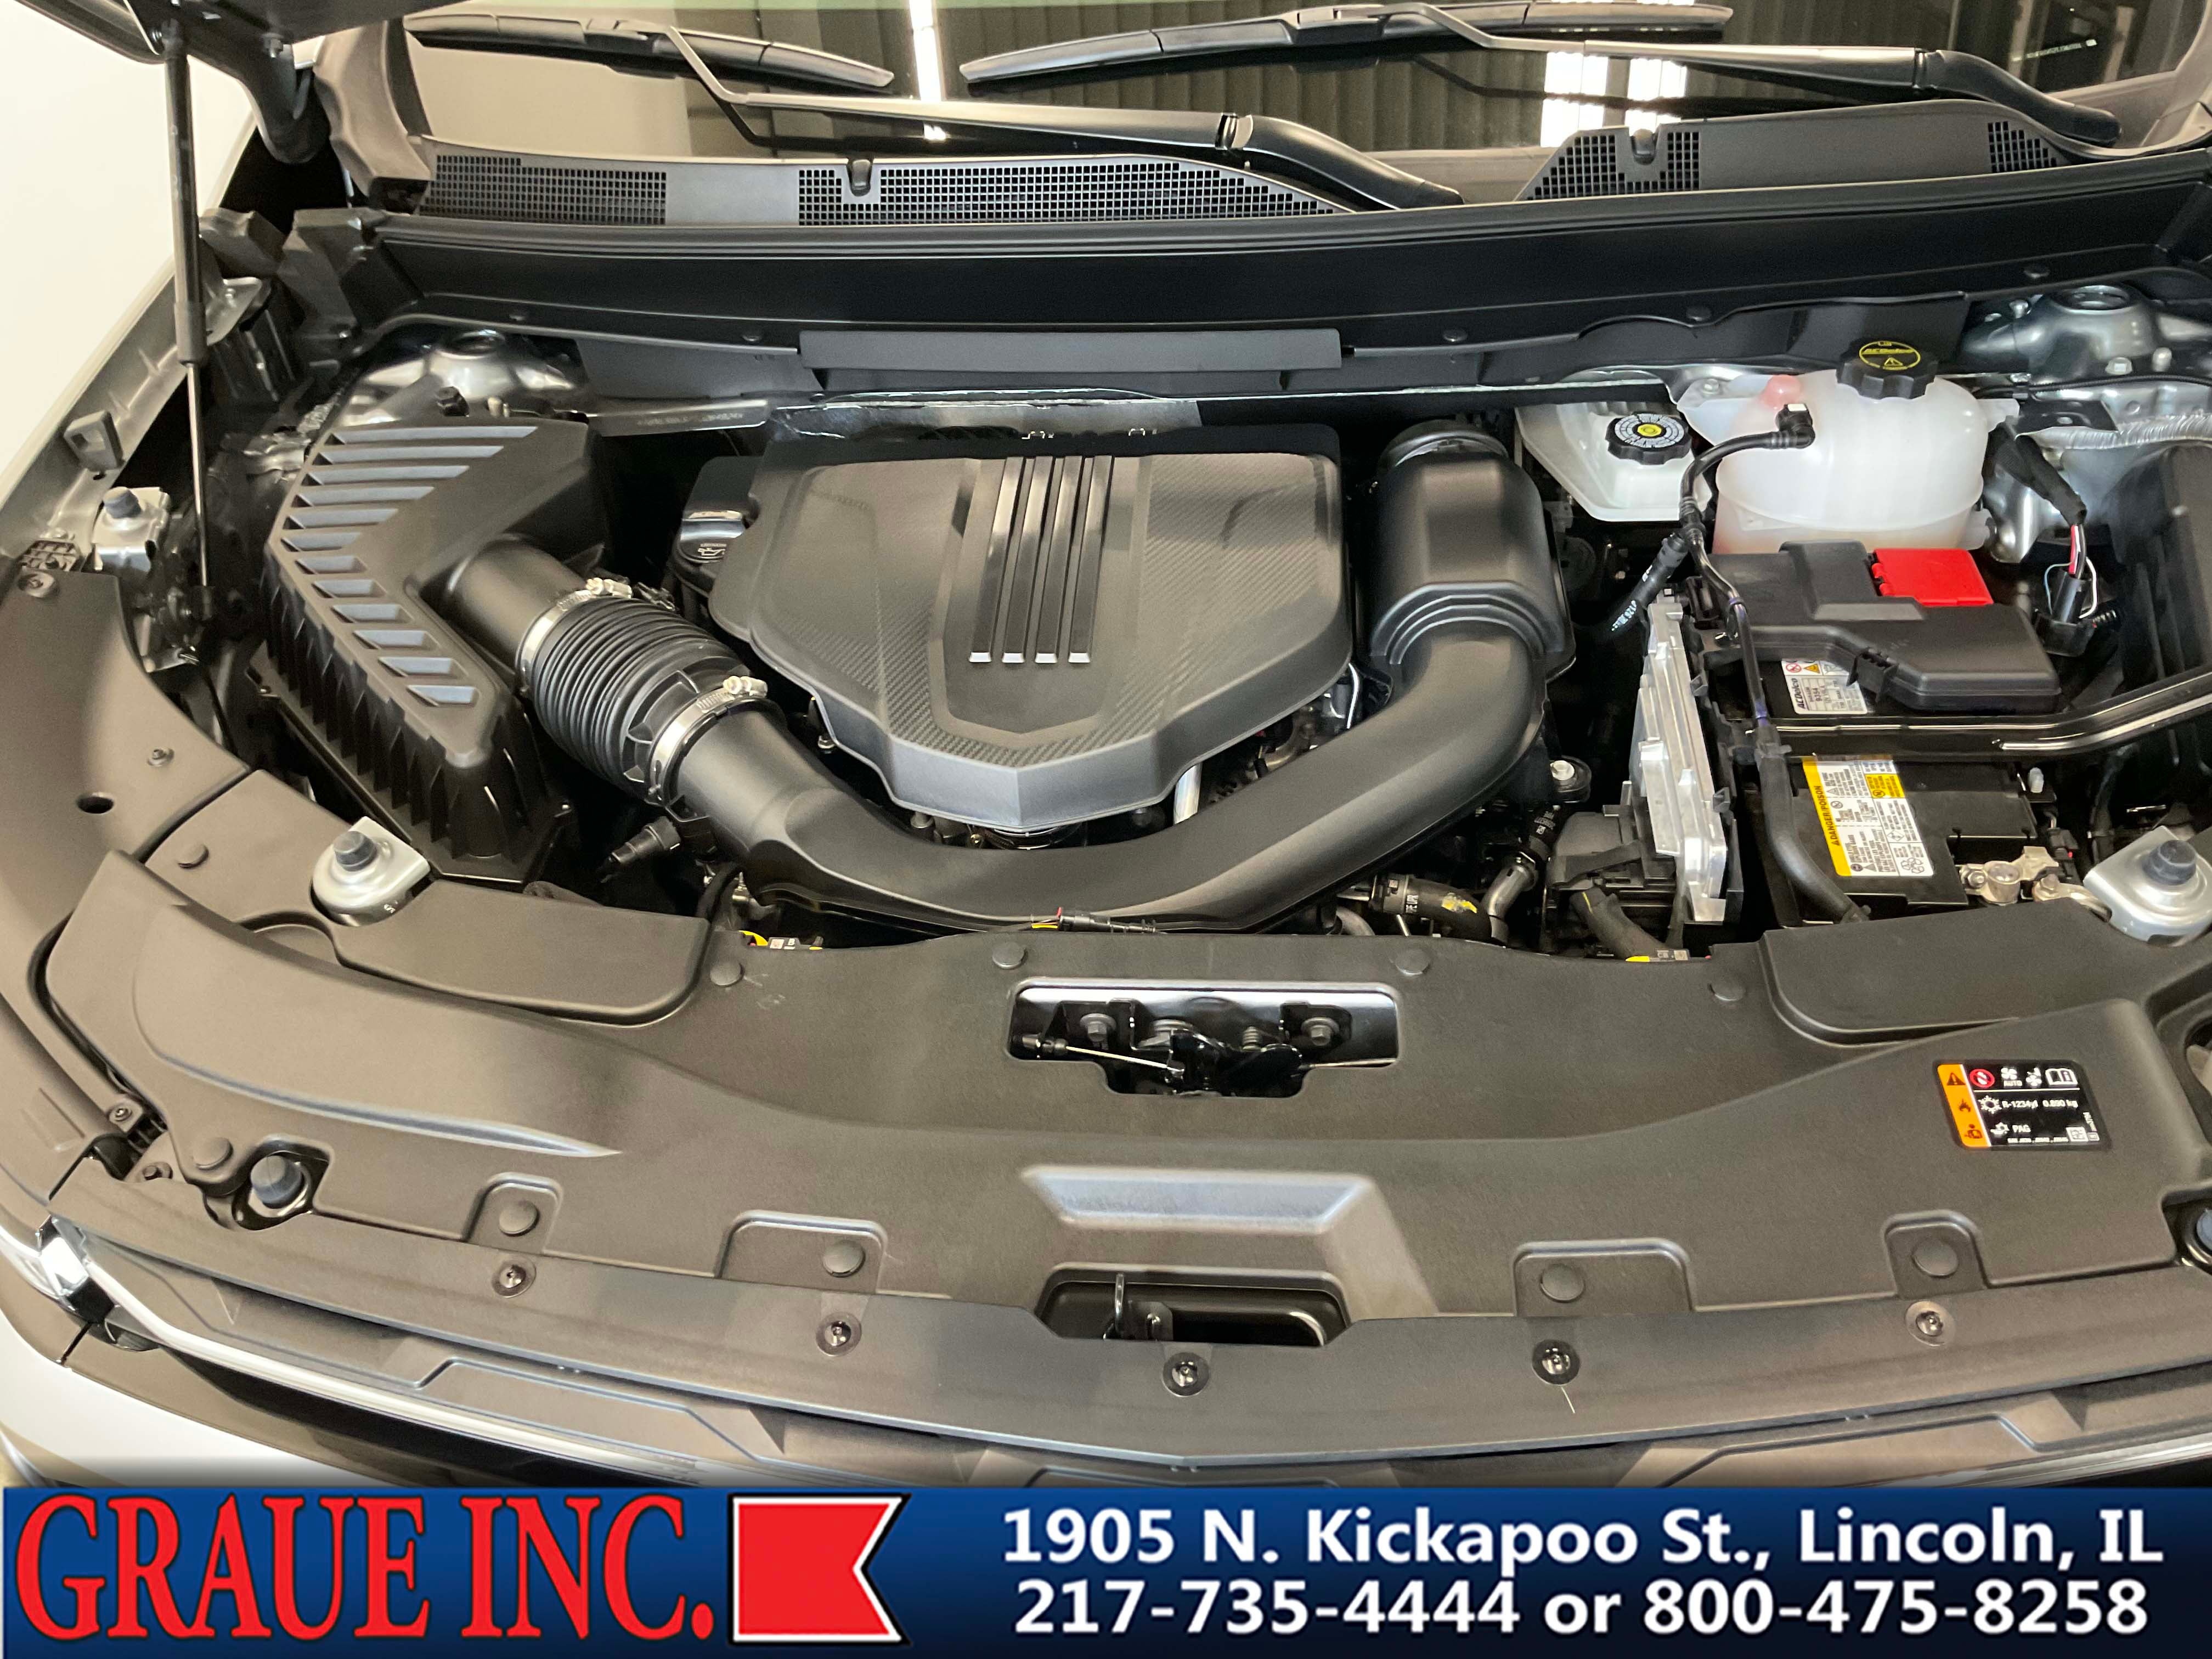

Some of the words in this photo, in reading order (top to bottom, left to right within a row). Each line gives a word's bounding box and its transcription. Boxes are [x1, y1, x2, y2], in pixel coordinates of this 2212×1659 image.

[1791, 678, 1806, 709] ACDelco
[1813, 785, 1841, 840] DANGER/POISON
[2012, 1124, 2031, 1133] PAG
